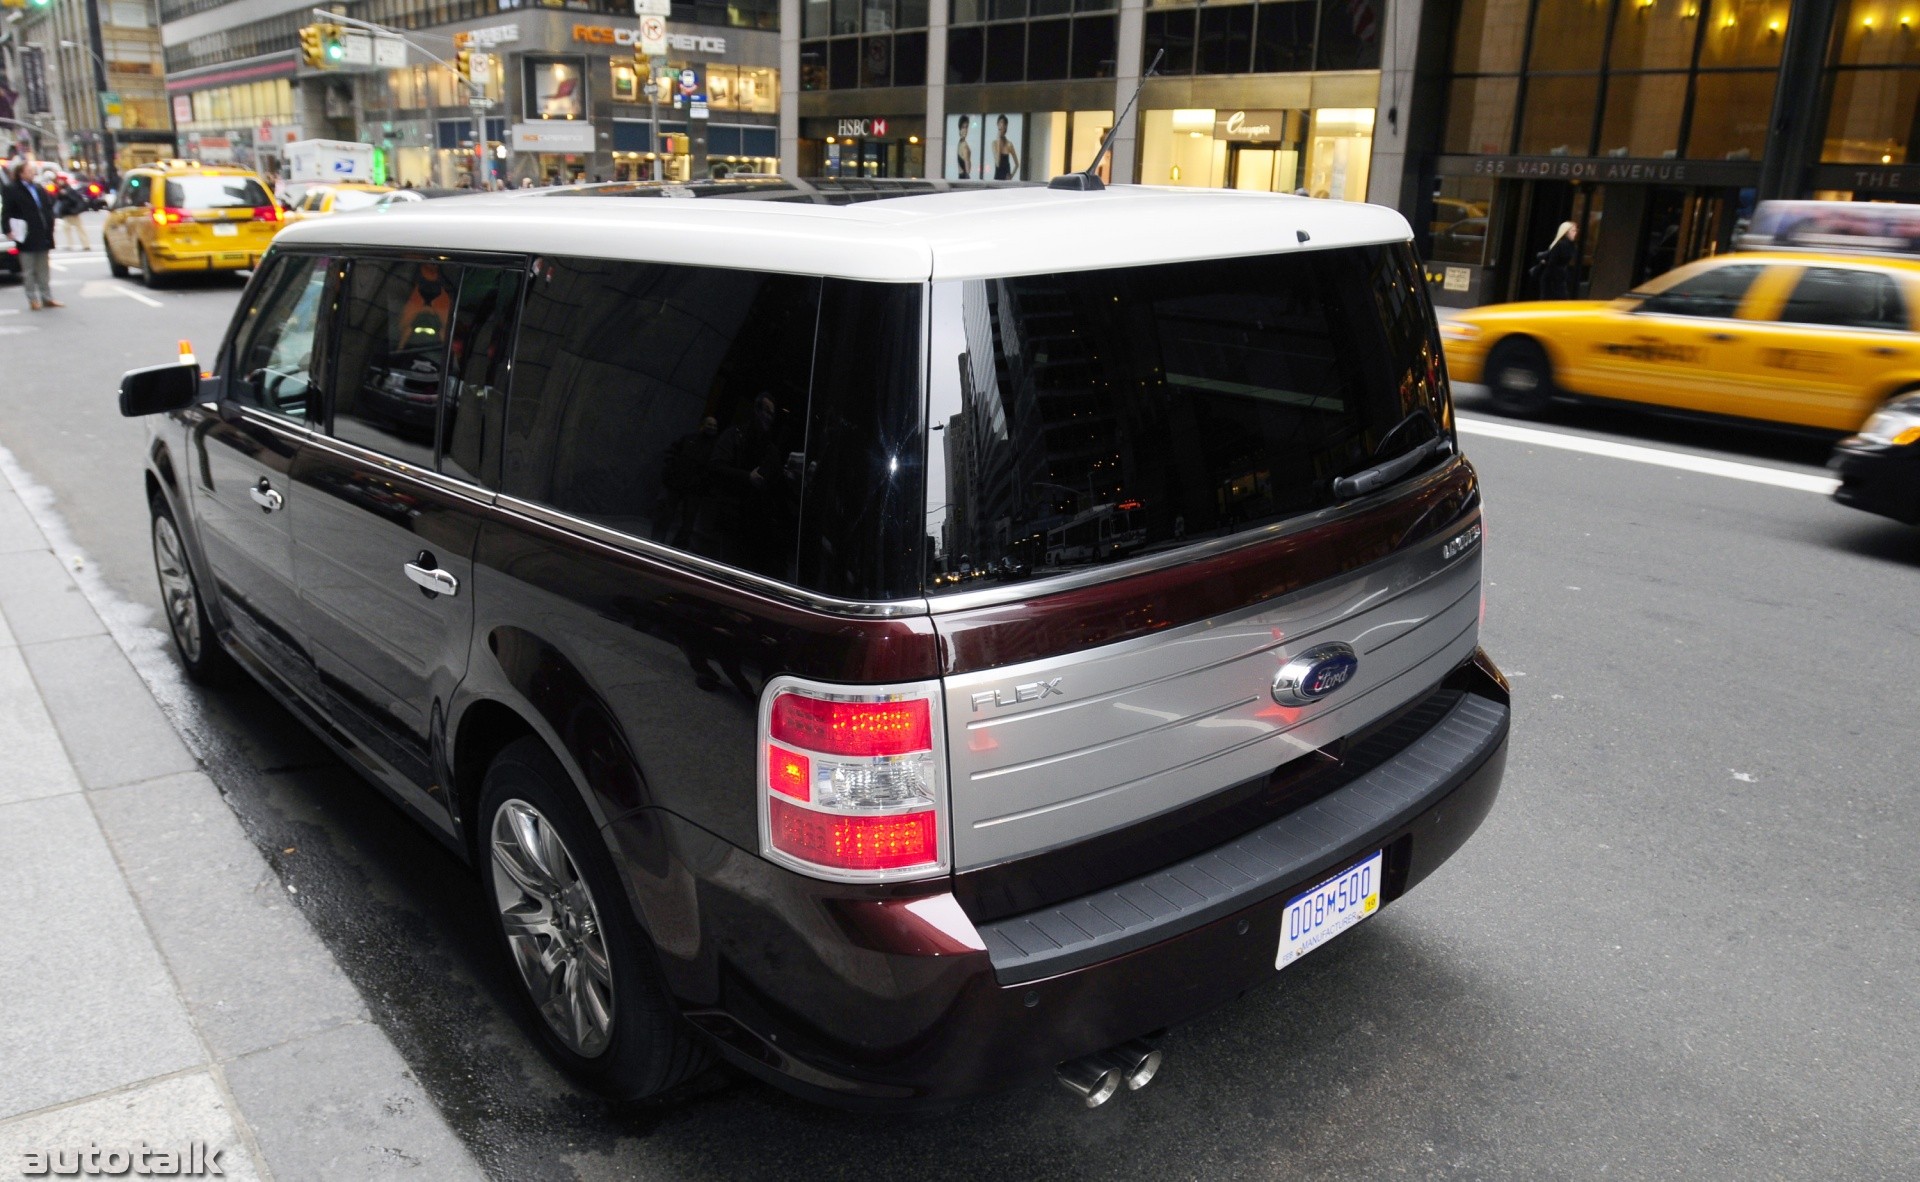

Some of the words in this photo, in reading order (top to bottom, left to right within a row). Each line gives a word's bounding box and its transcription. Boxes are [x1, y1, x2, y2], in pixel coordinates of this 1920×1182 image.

[838, 119, 869, 136] HSBC
[1517, 161, 1597, 176] MADISON
[1607, 164, 1686, 180] AVENUE
[1856, 172, 1901, 188] THE
[1314, 665, 1349, 692] Ford
[971, 677, 1064, 712] FLEX
